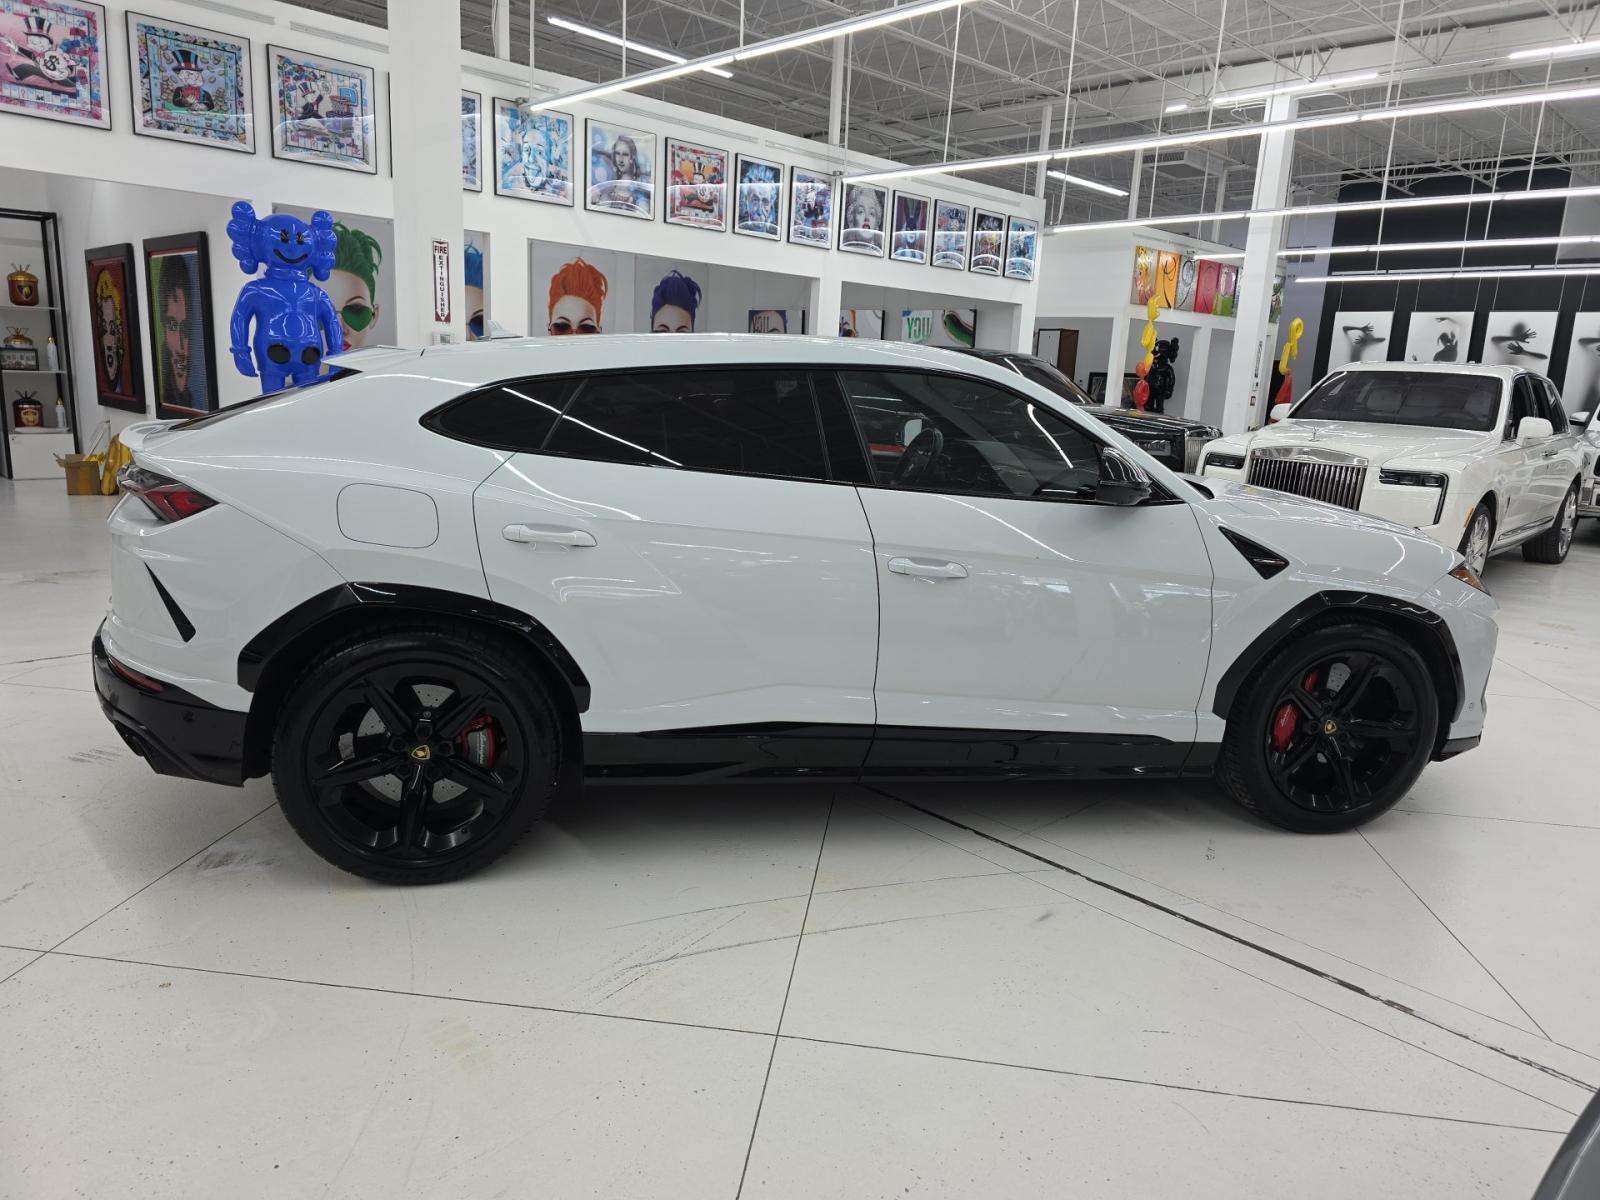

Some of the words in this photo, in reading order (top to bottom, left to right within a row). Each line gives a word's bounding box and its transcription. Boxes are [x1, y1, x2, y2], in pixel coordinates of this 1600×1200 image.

[434, 245, 447, 255] FIRE
[438, 255, 446, 317] EXTINGUISHER
[906, 317, 930, 339] YOU
